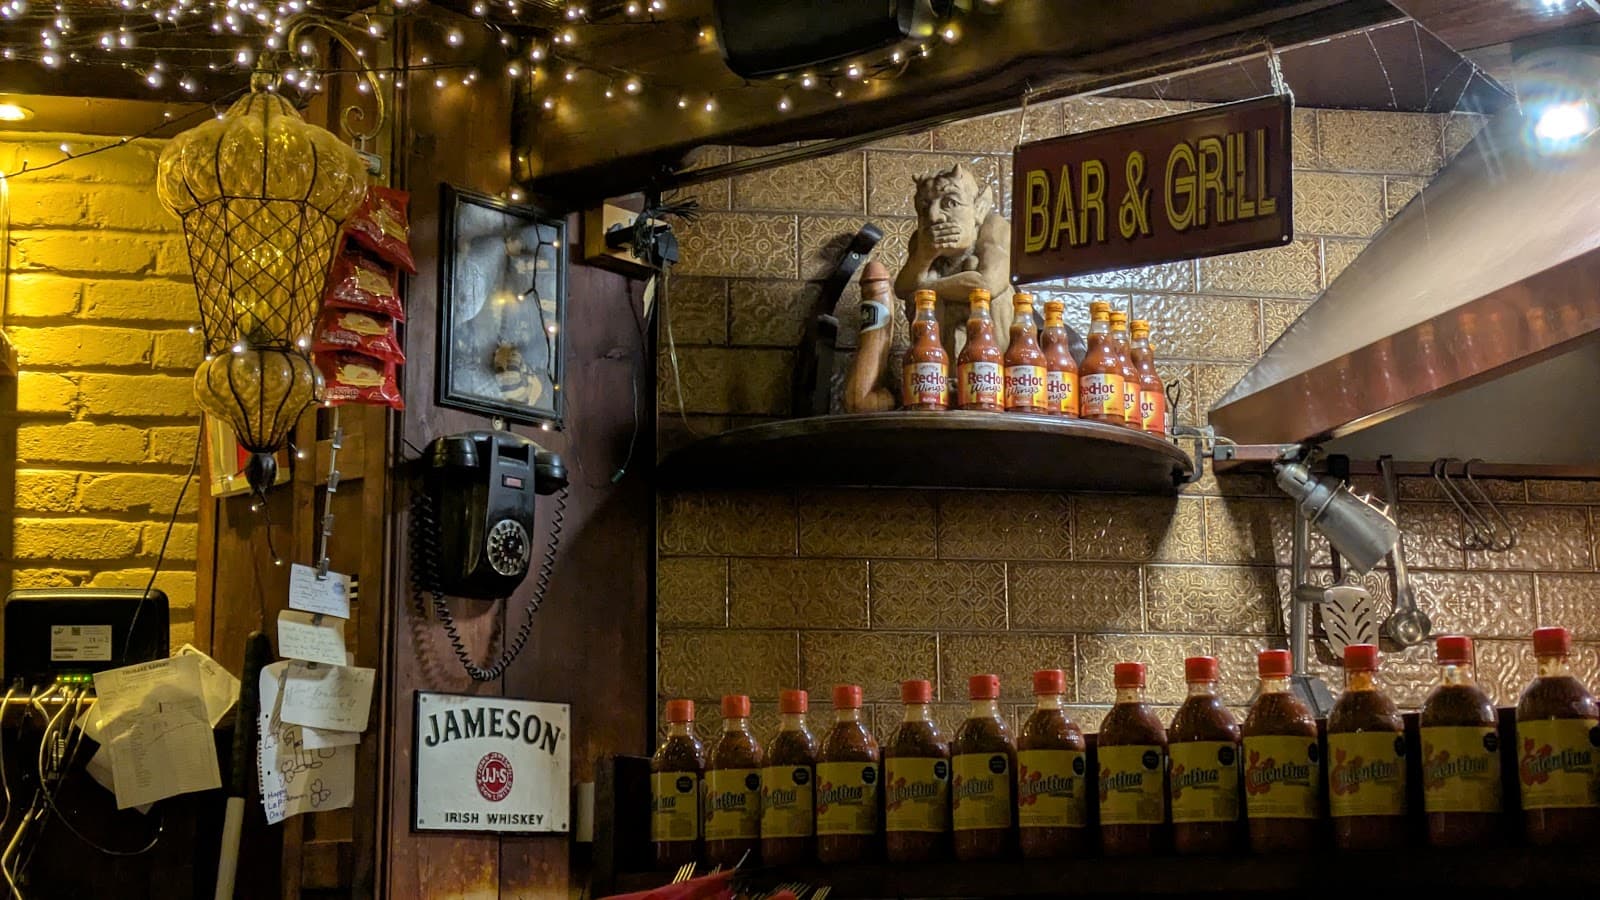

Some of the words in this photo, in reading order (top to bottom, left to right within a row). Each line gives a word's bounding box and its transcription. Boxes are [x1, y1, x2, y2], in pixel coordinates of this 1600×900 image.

[1024, 159, 1105, 253] BAR
[1119, 151, 1149, 239] &
[1165, 128, 1277, 231] GRILL
[425, 707, 561, 755] JAMESON
[445, 813, 479, 824] IRISH
[487, 813, 544, 825] WHISKEY
